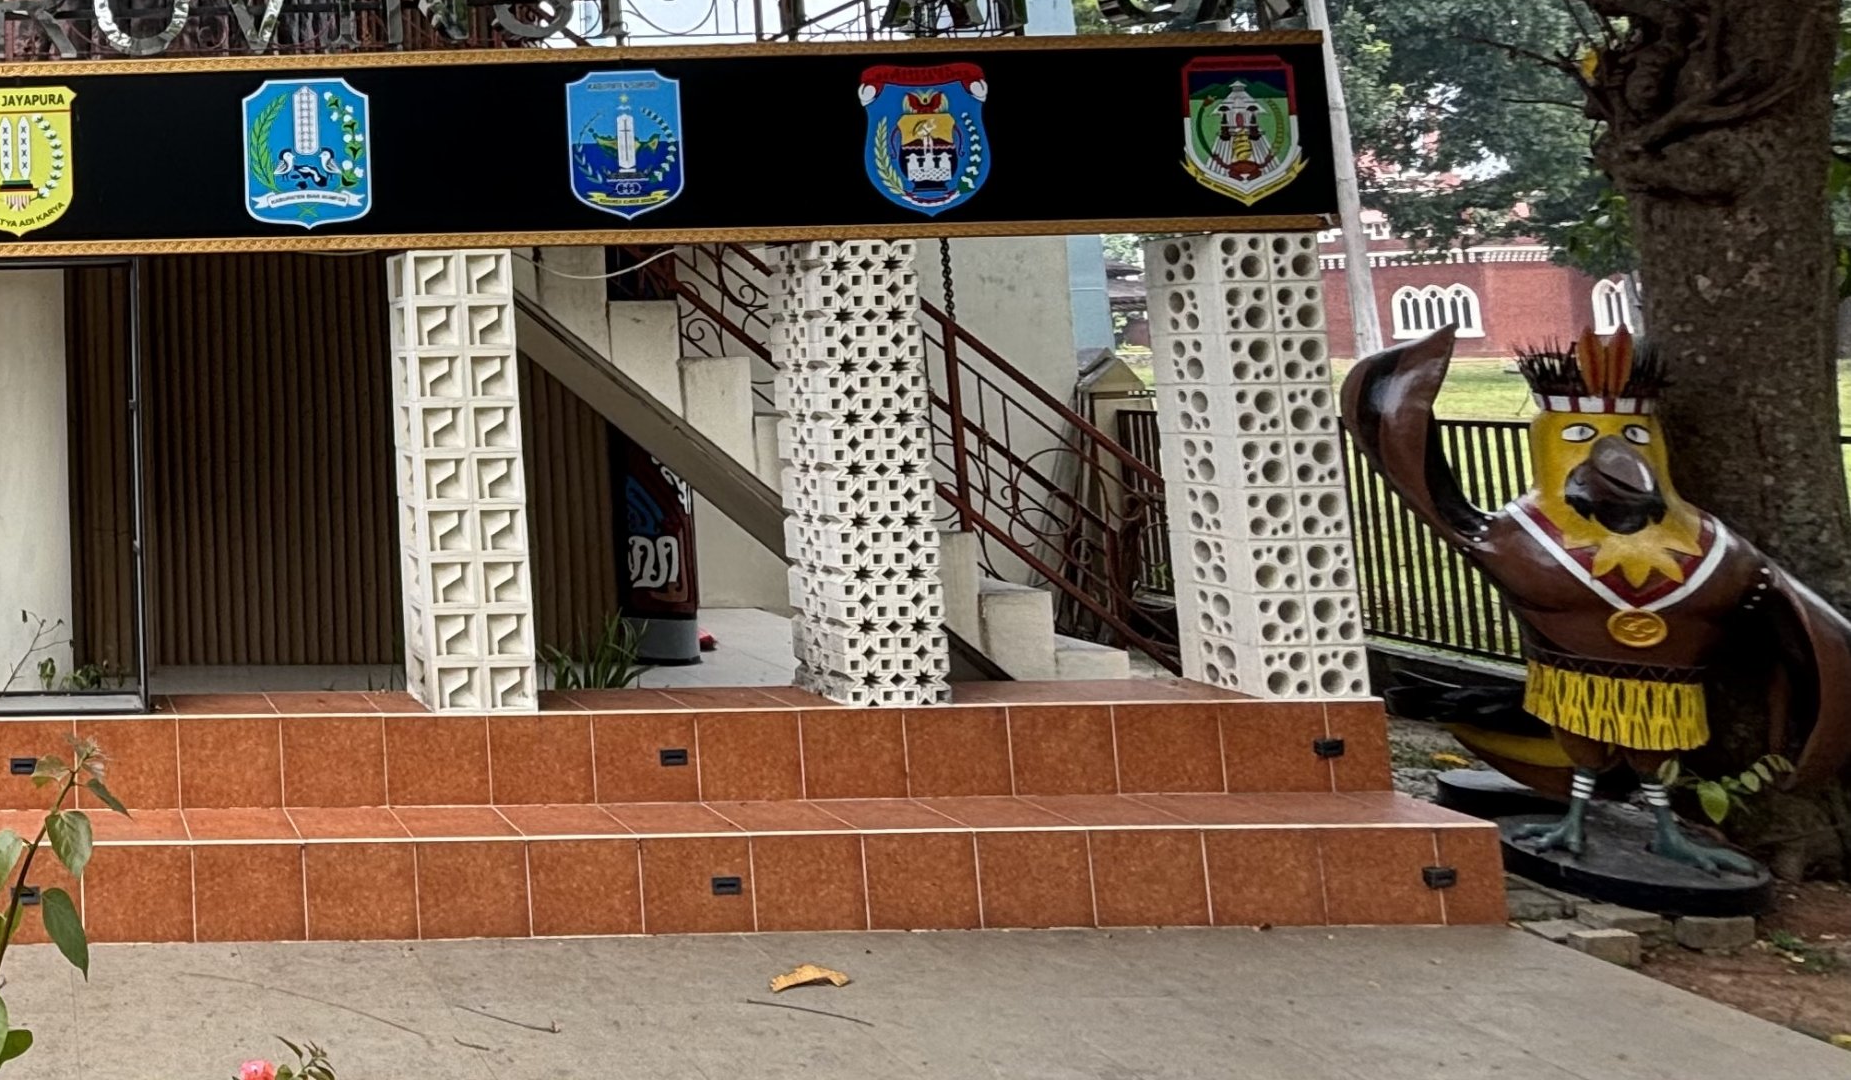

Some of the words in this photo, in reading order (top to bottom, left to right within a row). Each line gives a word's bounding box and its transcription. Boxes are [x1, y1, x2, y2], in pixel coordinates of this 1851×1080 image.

[1, 93, 65, 107] JAYAPURA
[19, 218, 35, 228] ADI
[36, 202, 65, 222] KARYA
